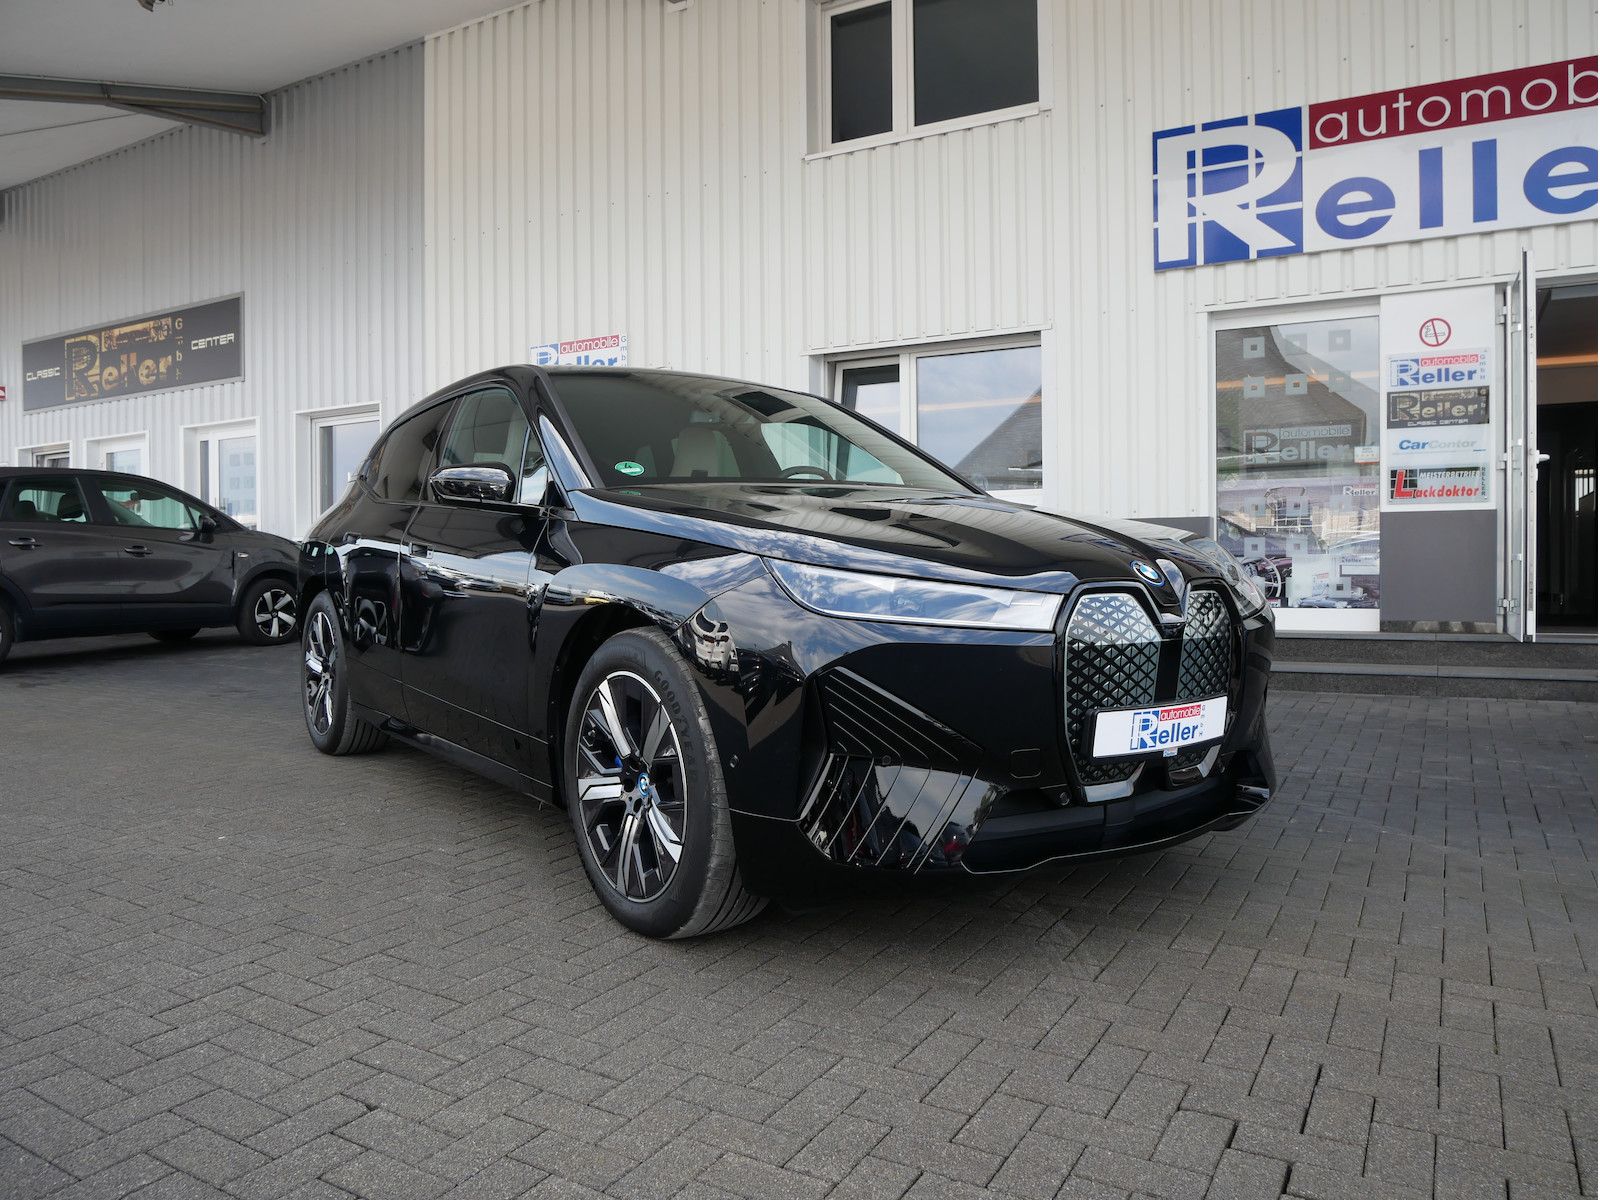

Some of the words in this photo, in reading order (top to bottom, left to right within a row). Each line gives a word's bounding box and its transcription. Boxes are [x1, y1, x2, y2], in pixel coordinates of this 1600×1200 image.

[1315, 62, 1599, 143] automob
[1155, 122, 1599, 266] Relle
[191, 333, 235, 350] CENTER
[561, 337, 619, 353] automobile
[531, 346, 618, 366] Rller
[1421, 354, 1478, 366] automobile
[26, 366, 61, 381] CLASSIC
[1390, 359, 1477, 387] Reller
[1281, 427, 1350, 439] automobile
[1420, 470, 1480, 479] MEISTERBETRIEB
[1394, 469, 1479, 498] Lackdoktor
[1161, 706, 1200, 720] automobile
[1130, 713, 1199, 749] Reller
